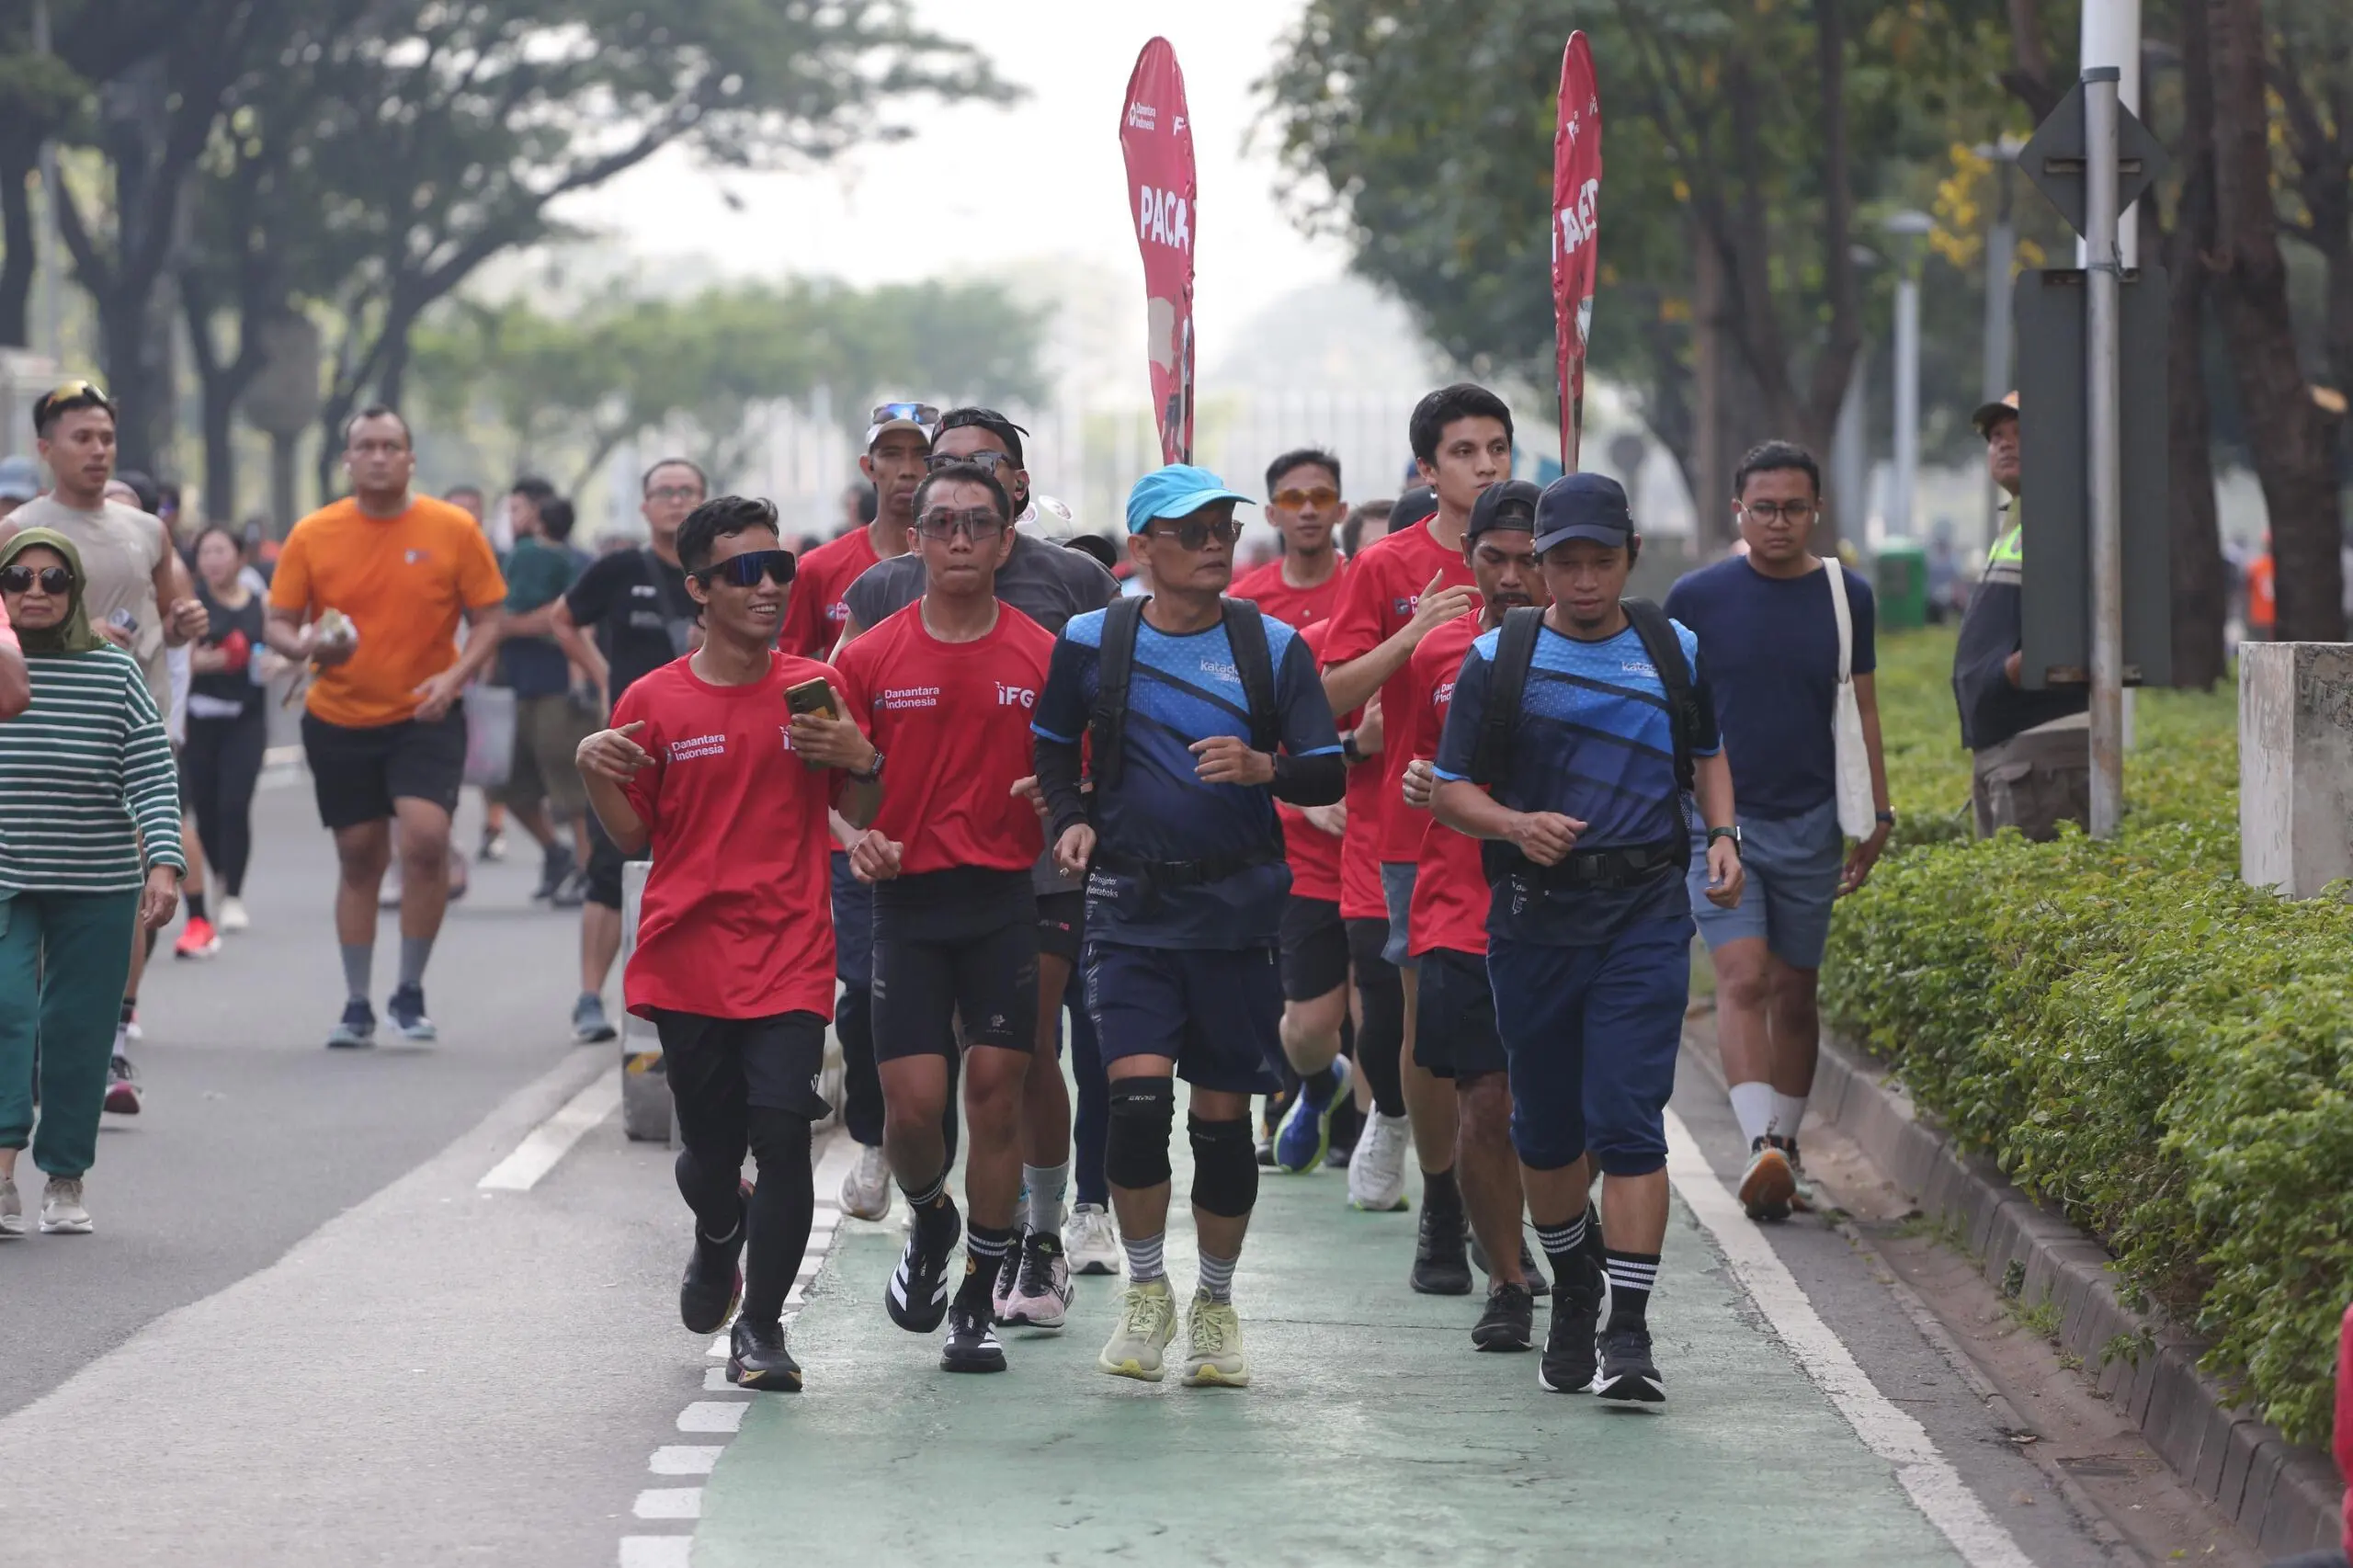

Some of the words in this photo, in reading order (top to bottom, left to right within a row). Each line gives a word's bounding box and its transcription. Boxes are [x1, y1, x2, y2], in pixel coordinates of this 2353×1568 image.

[884, 687, 940, 699] Danantara
[885, 697, 937, 710] Indonesia
[671, 733, 726, 752] Danantara
[675, 744, 724, 762] Indonesia
